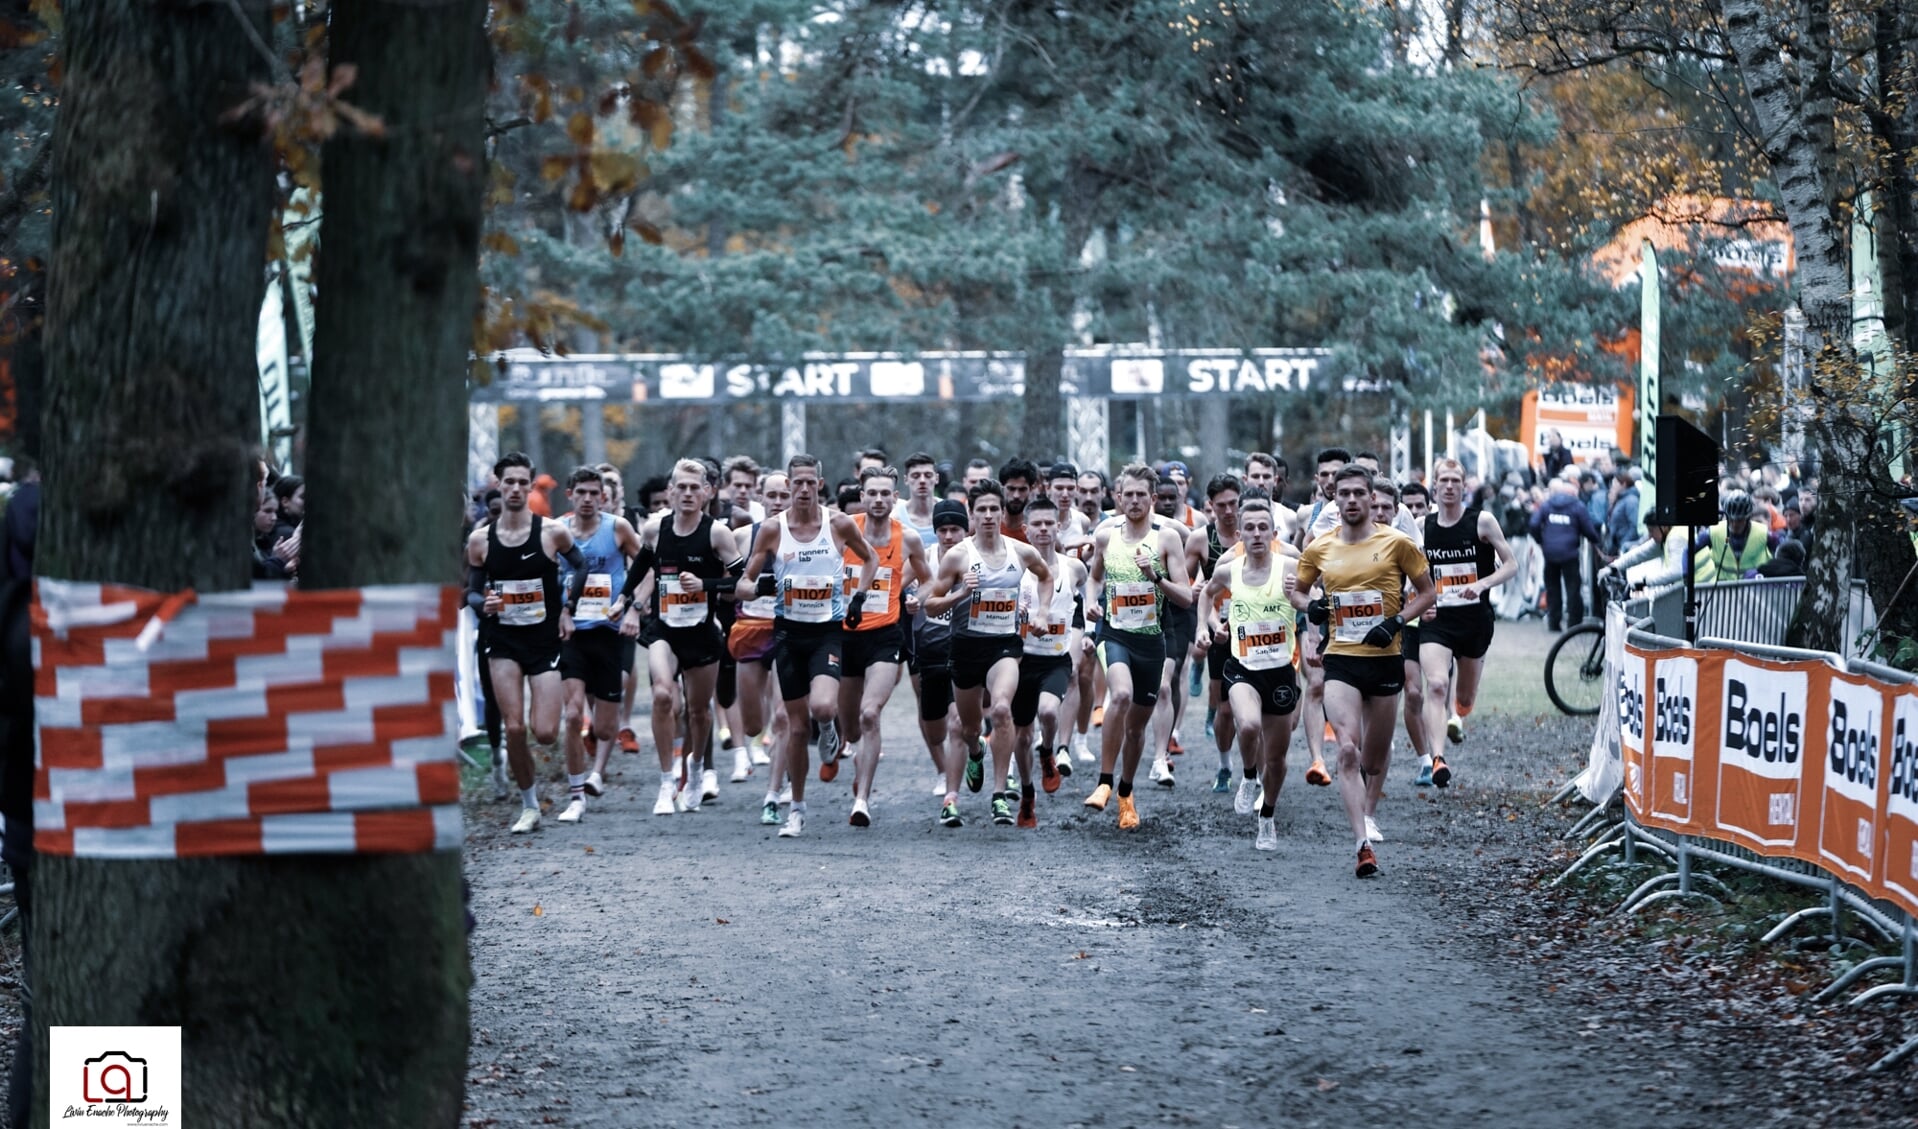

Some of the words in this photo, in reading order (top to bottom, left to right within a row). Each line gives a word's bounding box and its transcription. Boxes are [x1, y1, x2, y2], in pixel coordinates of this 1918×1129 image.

[1187, 357, 1319, 393] START
[798, 553, 812, 562] lab
[1450, 575, 1469, 586] 110
[511, 592, 535, 605] 139
[583, 587, 604, 598] 46
[797, 588, 828, 600] 1107
[674, 593, 699, 605] 104
[1122, 595, 1148, 607] 105
[798, 601, 825, 610] Yannick
[984, 600, 1013, 612] 1106
[1348, 605, 1374, 618] 160
[1249, 633, 1281, 647] 1108
[1656, 675, 1691, 745] Boels
[1726, 679, 1801, 764] Boels
[1831, 699, 1878, 790] Boels
